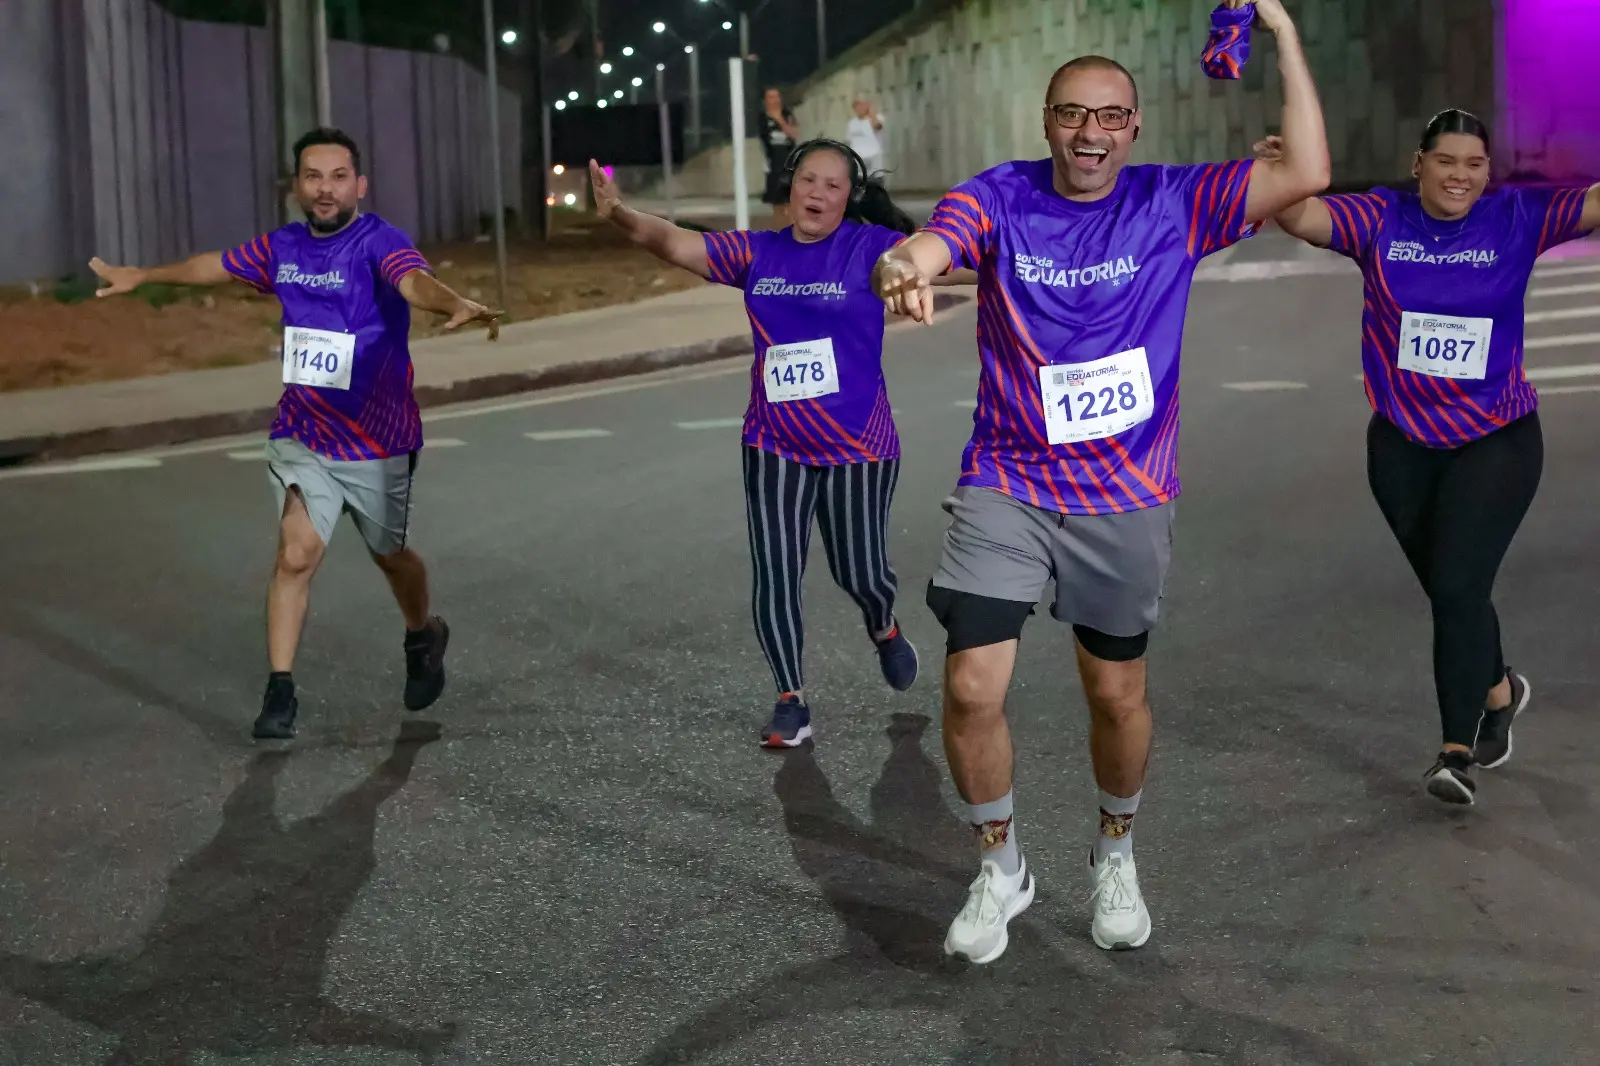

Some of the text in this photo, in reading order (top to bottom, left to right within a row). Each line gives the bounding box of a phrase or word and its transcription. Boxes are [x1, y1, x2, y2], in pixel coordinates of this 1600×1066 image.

[1391, 241, 1424, 251] corrida
[1015, 253, 1054, 267] corrida
[1387, 248, 1499, 264] EQUATORIAL
[276, 270, 345, 287] EQUATORIAL
[1015, 255, 1141, 288] EQUATORIAL
[752, 282, 846, 296] EQUATORIAL
[1422, 321, 1467, 330] EQUATORIAL
[776, 349, 812, 358] EQUATORIAL
[1410, 335, 1476, 362] 1087
[292, 347, 338, 373] 1140
[771, 361, 825, 387] 1478
[1066, 364, 1120, 381] EQUATORIAL
[1057, 381, 1137, 422] 1228
